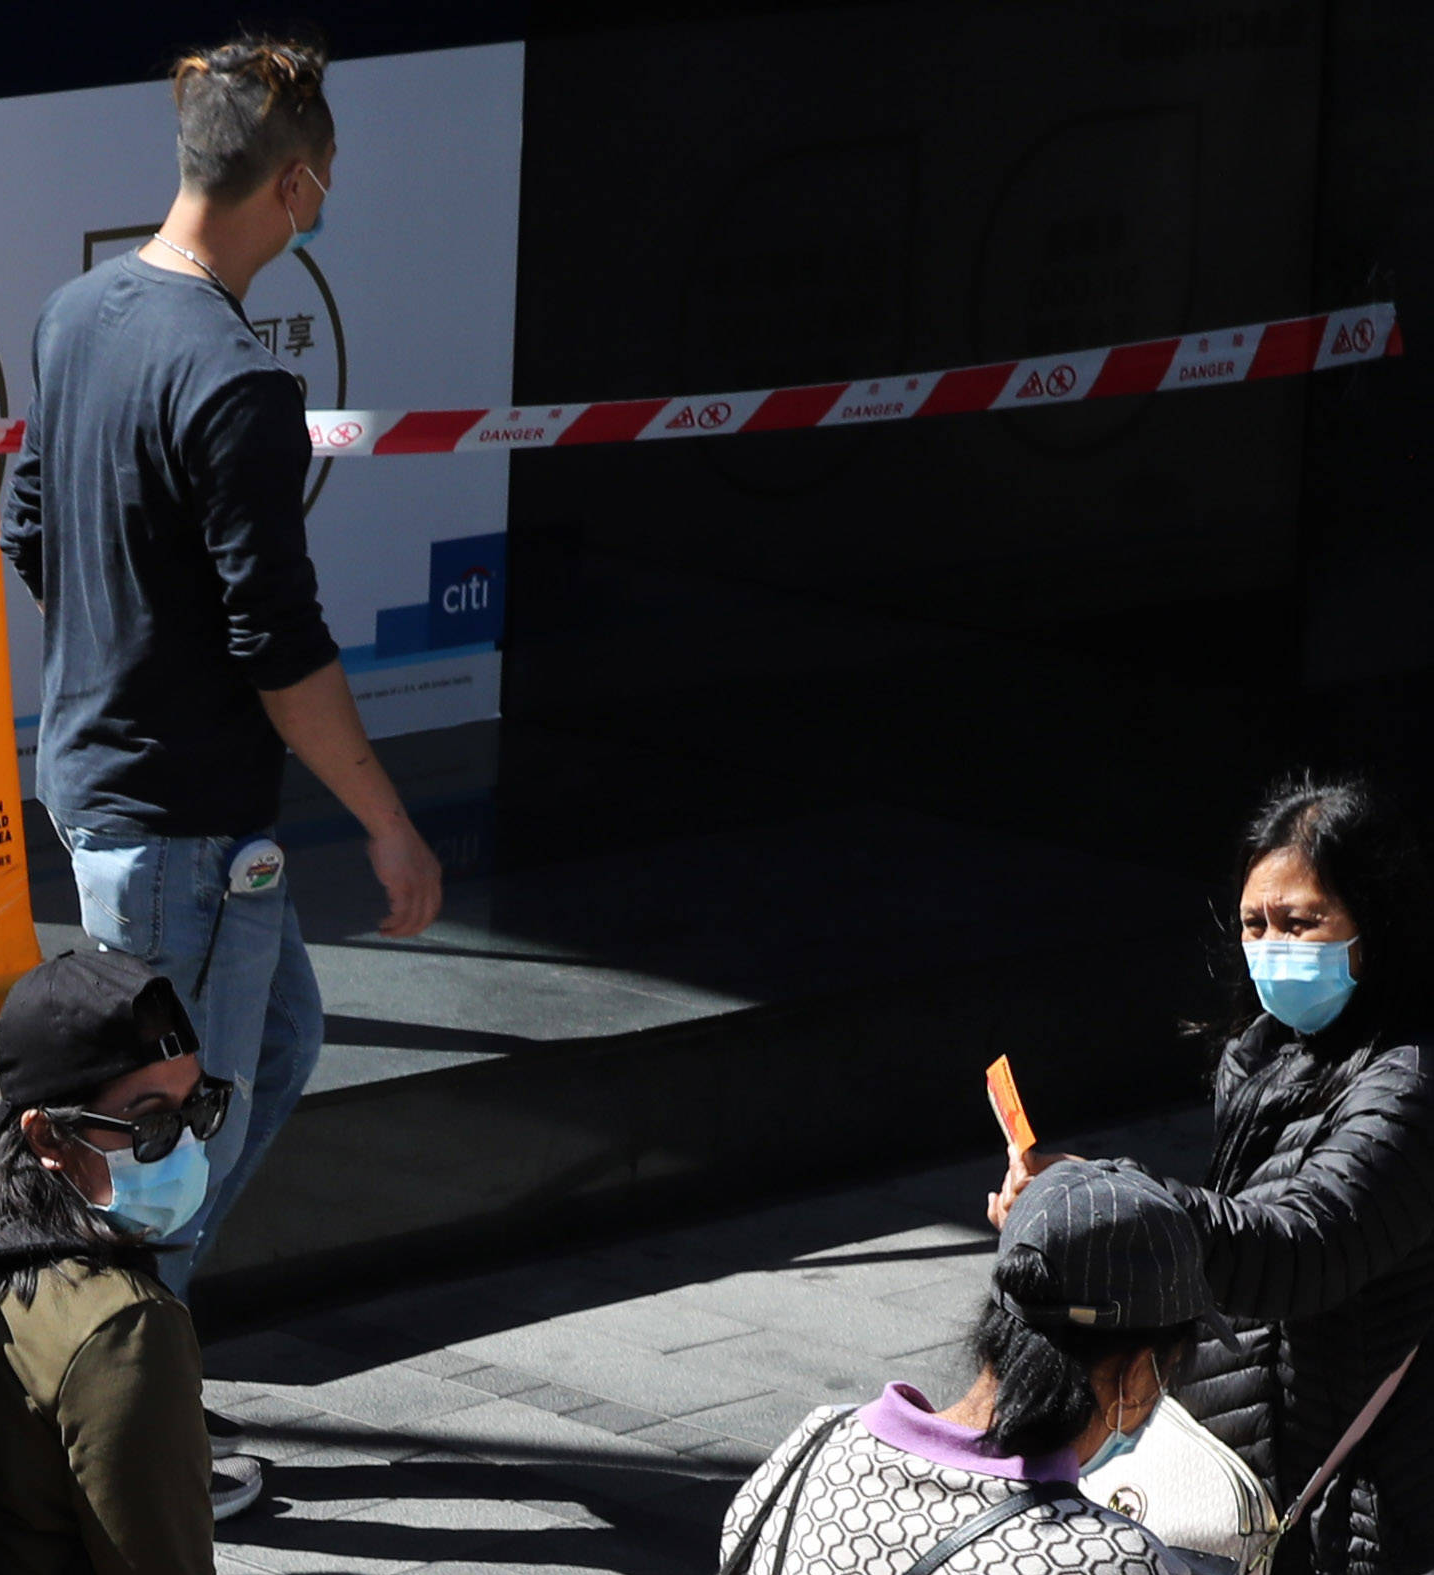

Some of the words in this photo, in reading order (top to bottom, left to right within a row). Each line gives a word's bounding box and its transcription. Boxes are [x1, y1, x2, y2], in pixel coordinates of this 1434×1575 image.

[1179, 361, 1235, 381] DANGER
[842, 402, 904, 419] DANGER
[479, 428, 544, 442] DANGER
[442, 573, 489, 615] citi
